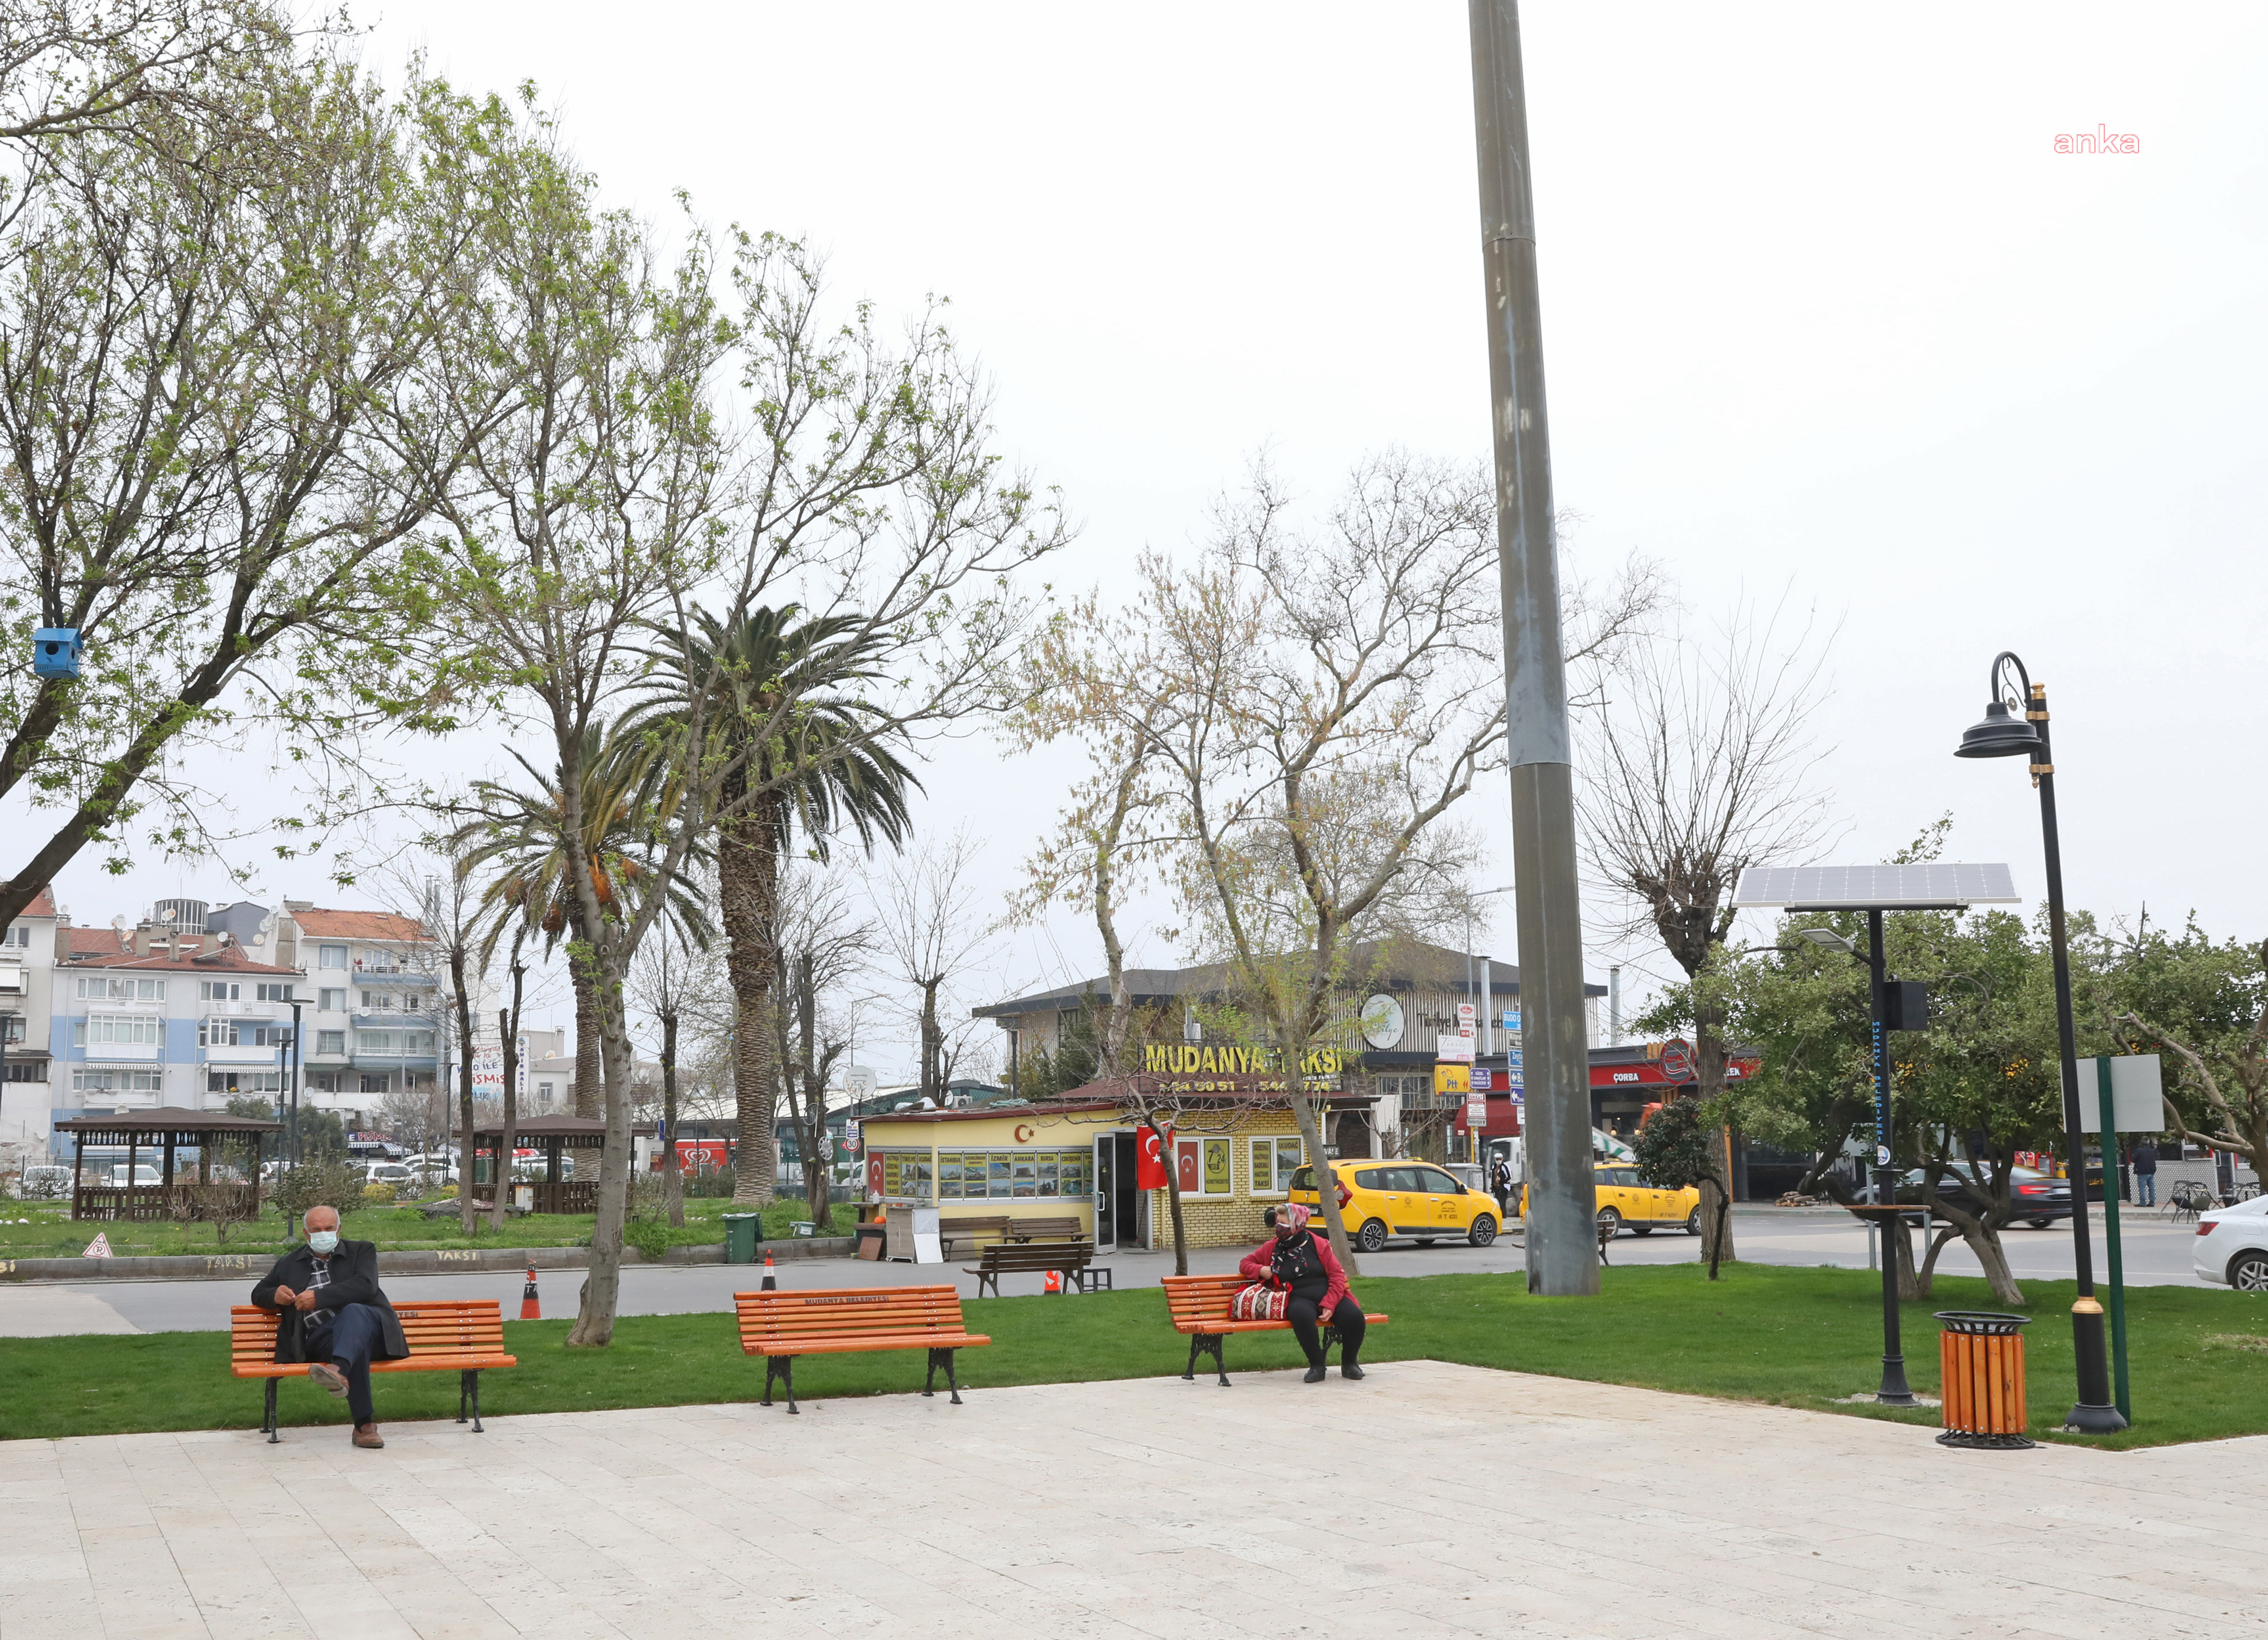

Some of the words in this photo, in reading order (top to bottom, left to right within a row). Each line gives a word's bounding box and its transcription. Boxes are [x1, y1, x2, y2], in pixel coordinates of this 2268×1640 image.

[1417, 1012, 1451, 1032] Tilye
[1503, 1014, 1516, 1022] BUDO
[1146, 1045, 1266, 1074] MUDANYA
[472, 1074, 506, 1085] İŞMİŞ
[1447, 1079, 1458, 1089] Ptt
[1613, 1073, 1639, 1084] ÇORBA
